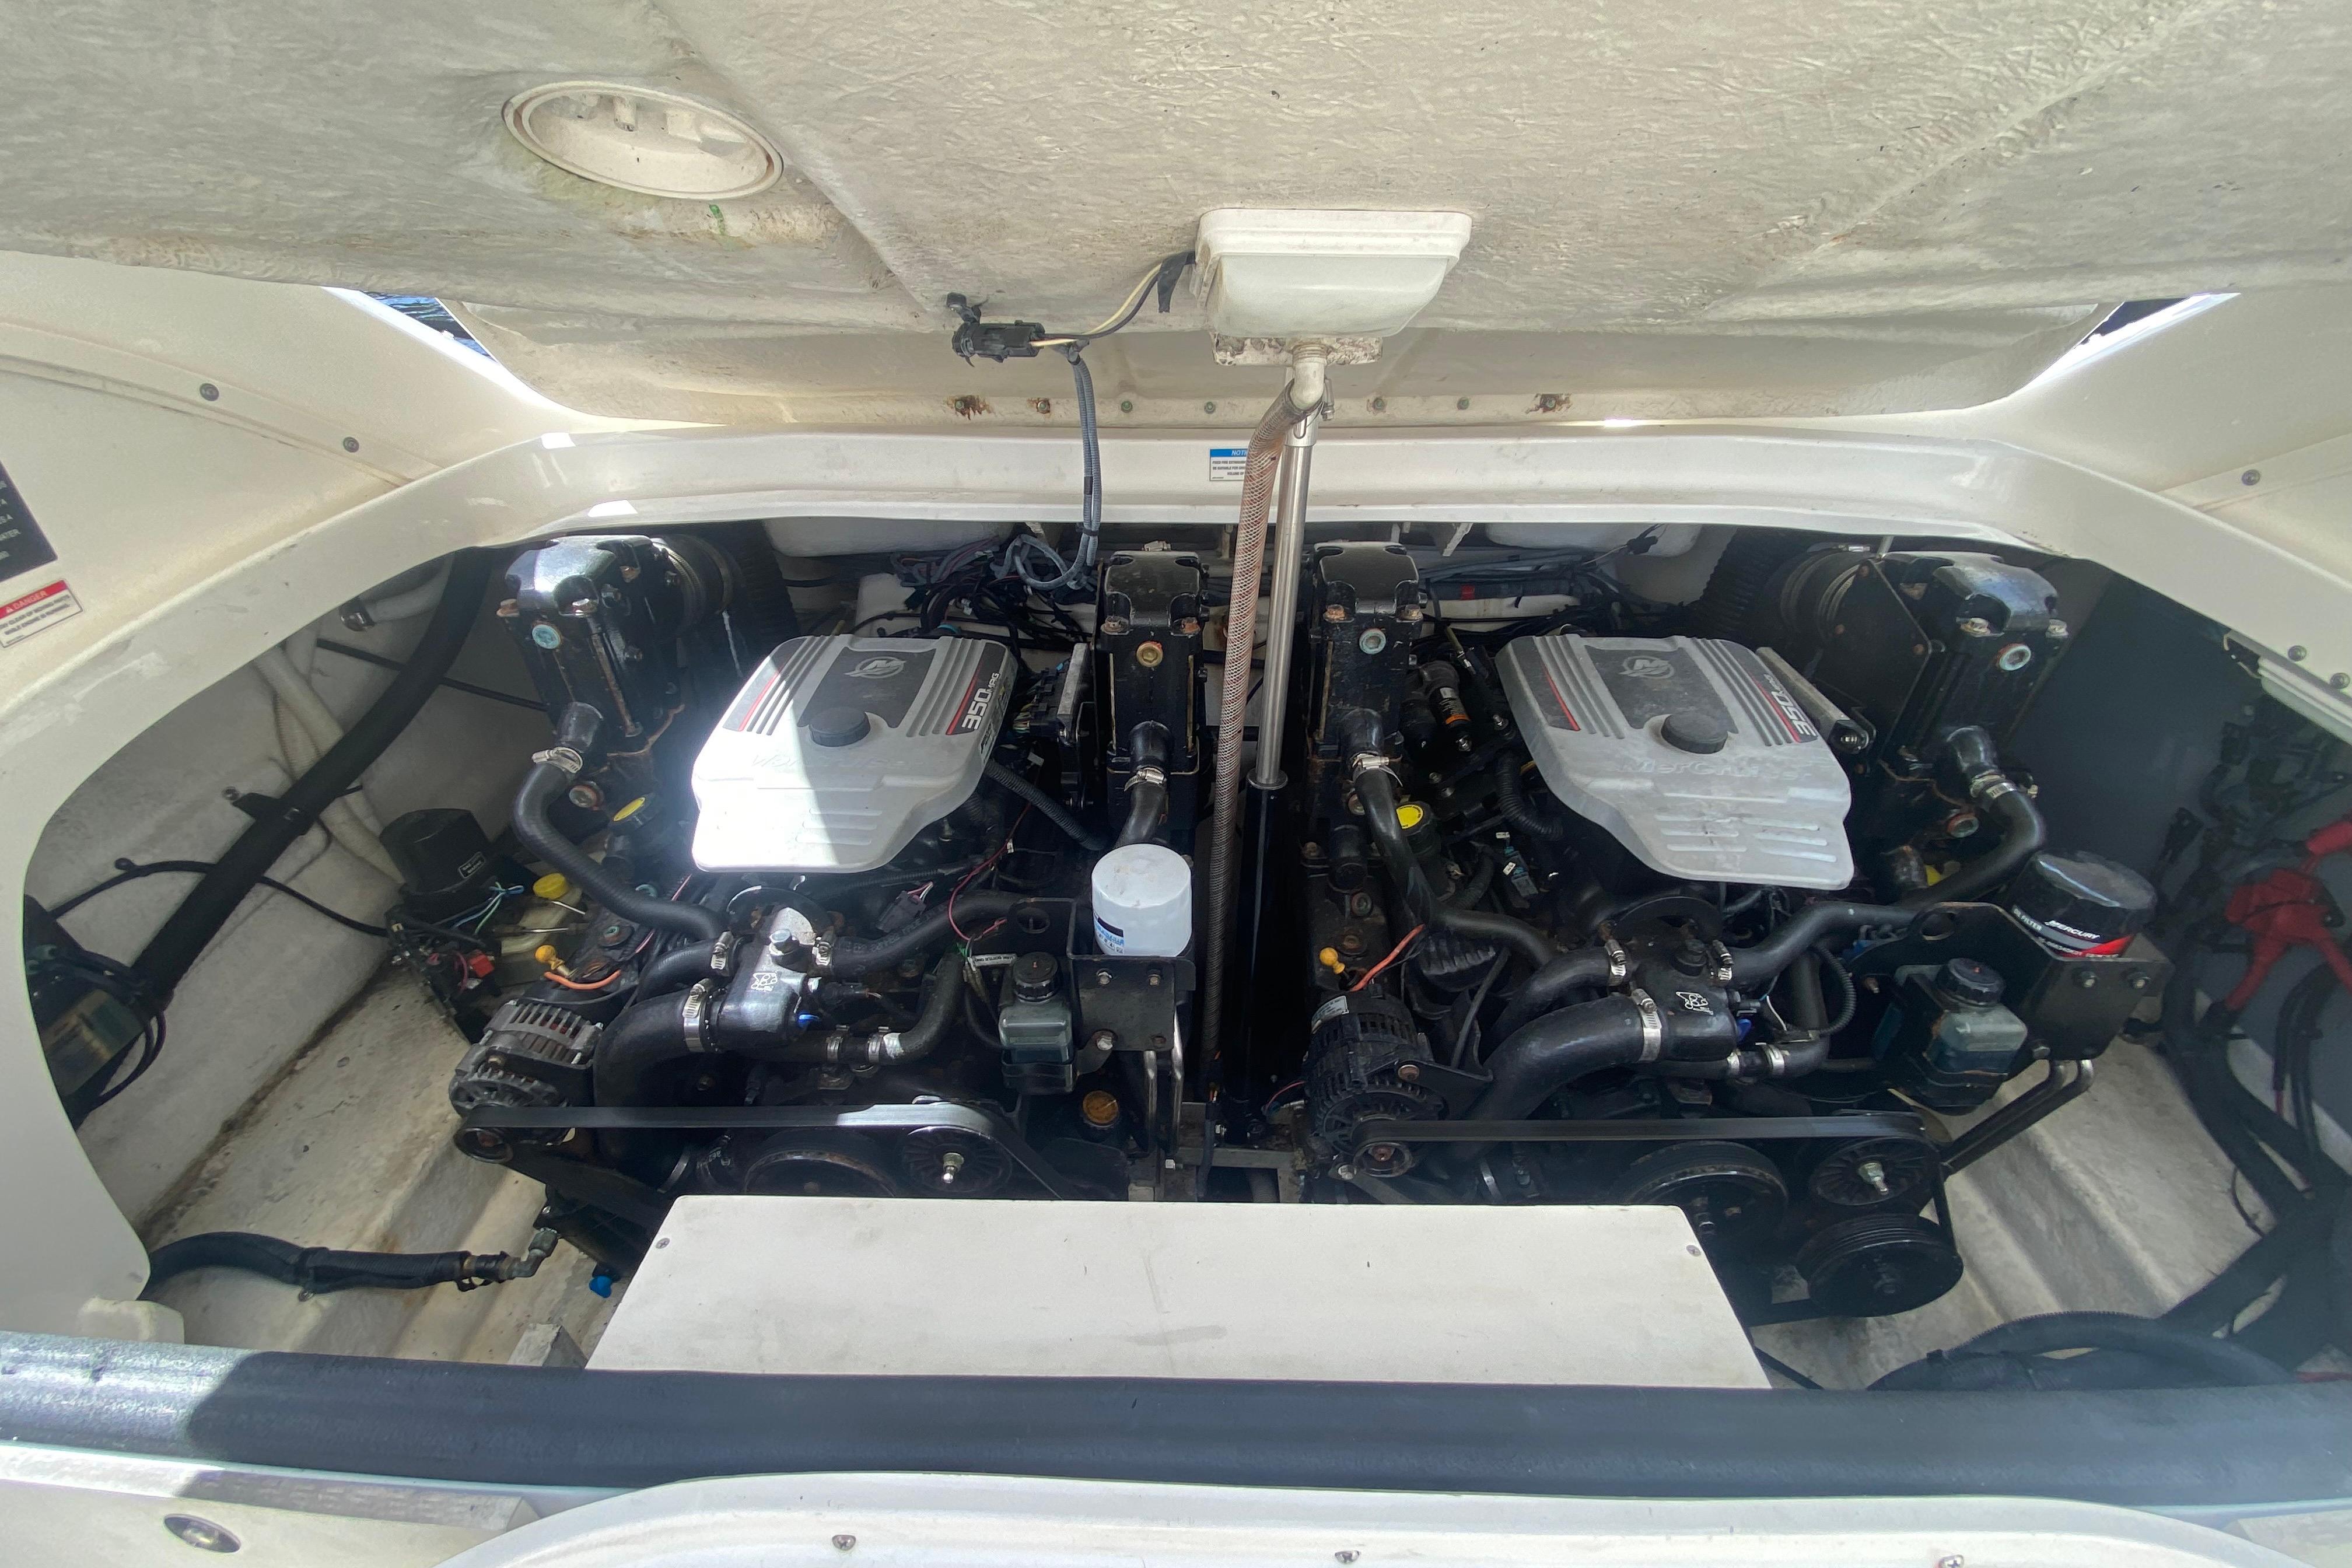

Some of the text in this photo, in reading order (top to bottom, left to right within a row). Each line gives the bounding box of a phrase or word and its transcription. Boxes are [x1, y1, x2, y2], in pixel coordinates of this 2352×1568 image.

[13, 590, 47, 610] DANGER
[962, 688, 992, 730] 350
[986, 672, 1000, 692] MAG
[1771, 691, 1817, 736] 350
[2021, 915, 2042, 932] FILTER
[2044, 919, 2101, 940] MERCURY
